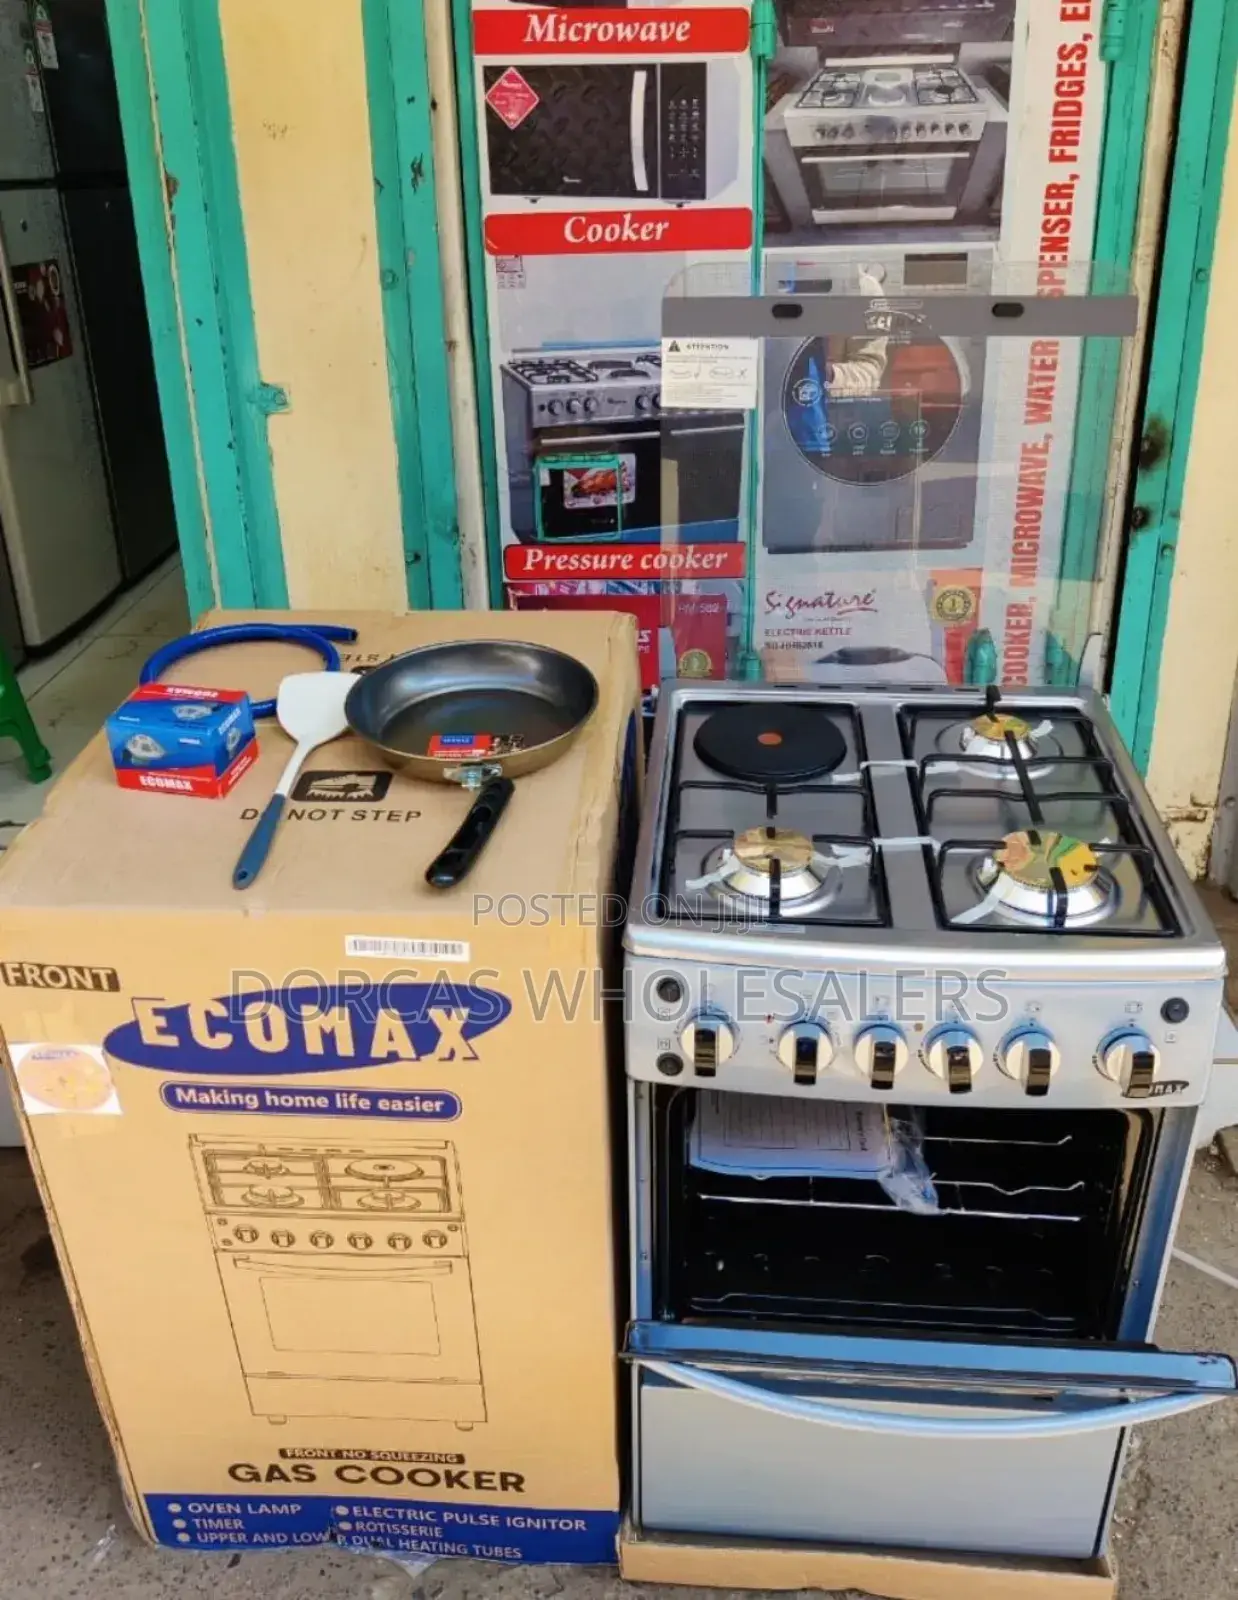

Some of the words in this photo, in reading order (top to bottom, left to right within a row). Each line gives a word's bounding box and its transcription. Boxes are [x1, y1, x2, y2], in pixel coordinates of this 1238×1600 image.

[523, 13, 691, 43] Microwave
[1049, 32, 1093, 163] FRIDGES,
[563, 212, 670, 244] Cooker
[1037, 173, 1080, 298] SPENSER,
[1023, 340, 1060, 425] WATER
[1009, 434, 1053, 587] MICROWAVE,
[523, 548, 634, 572] Pressure
[639, 546, 729, 570] cooker
[764, 587, 876, 620] Signature
[764, 628, 812, 637] ELECTRIC
[815, 626, 853, 637] KETTLE
[139, 774, 194, 792] ECOMAX
[287, 808, 346, 822] NOT
[351, 809, 422, 823] STEP
[3, 963, 114, 992] FRONT
[131, 997, 480, 1062] ECOMAX
[176, 1087, 260, 1109] Making
[265, 1090, 328, 1109] home
[336, 1092, 372, 1111] life
[378, 1097, 445, 1114] easier
[286, 1449, 337, 1459] FRONT
[341, 1449, 367, 1460] NO
[370, 1450, 458, 1464] SQUEEZING
[228, 1462, 318, 1484] GAS
[335, 1464, 526, 1493] COOKER
[187, 1502, 242, 1515] OVEN
[247, 1503, 303, 1516] LAMP
[193, 1517, 246, 1530] TIMER
[352, 1505, 438, 1522] ELECTRIC
[443, 1511, 500, 1527] PULSE
[506, 1516, 588, 1532] IGNITOR
[355, 1521, 444, 1538] ROTISSERIE
[196, 1531, 249, 1544] UPPER
[252, 1532, 289, 1545] AND
[398, 1537, 469, 1555] HEATING
[472, 1544, 523, 1560] TUBES
